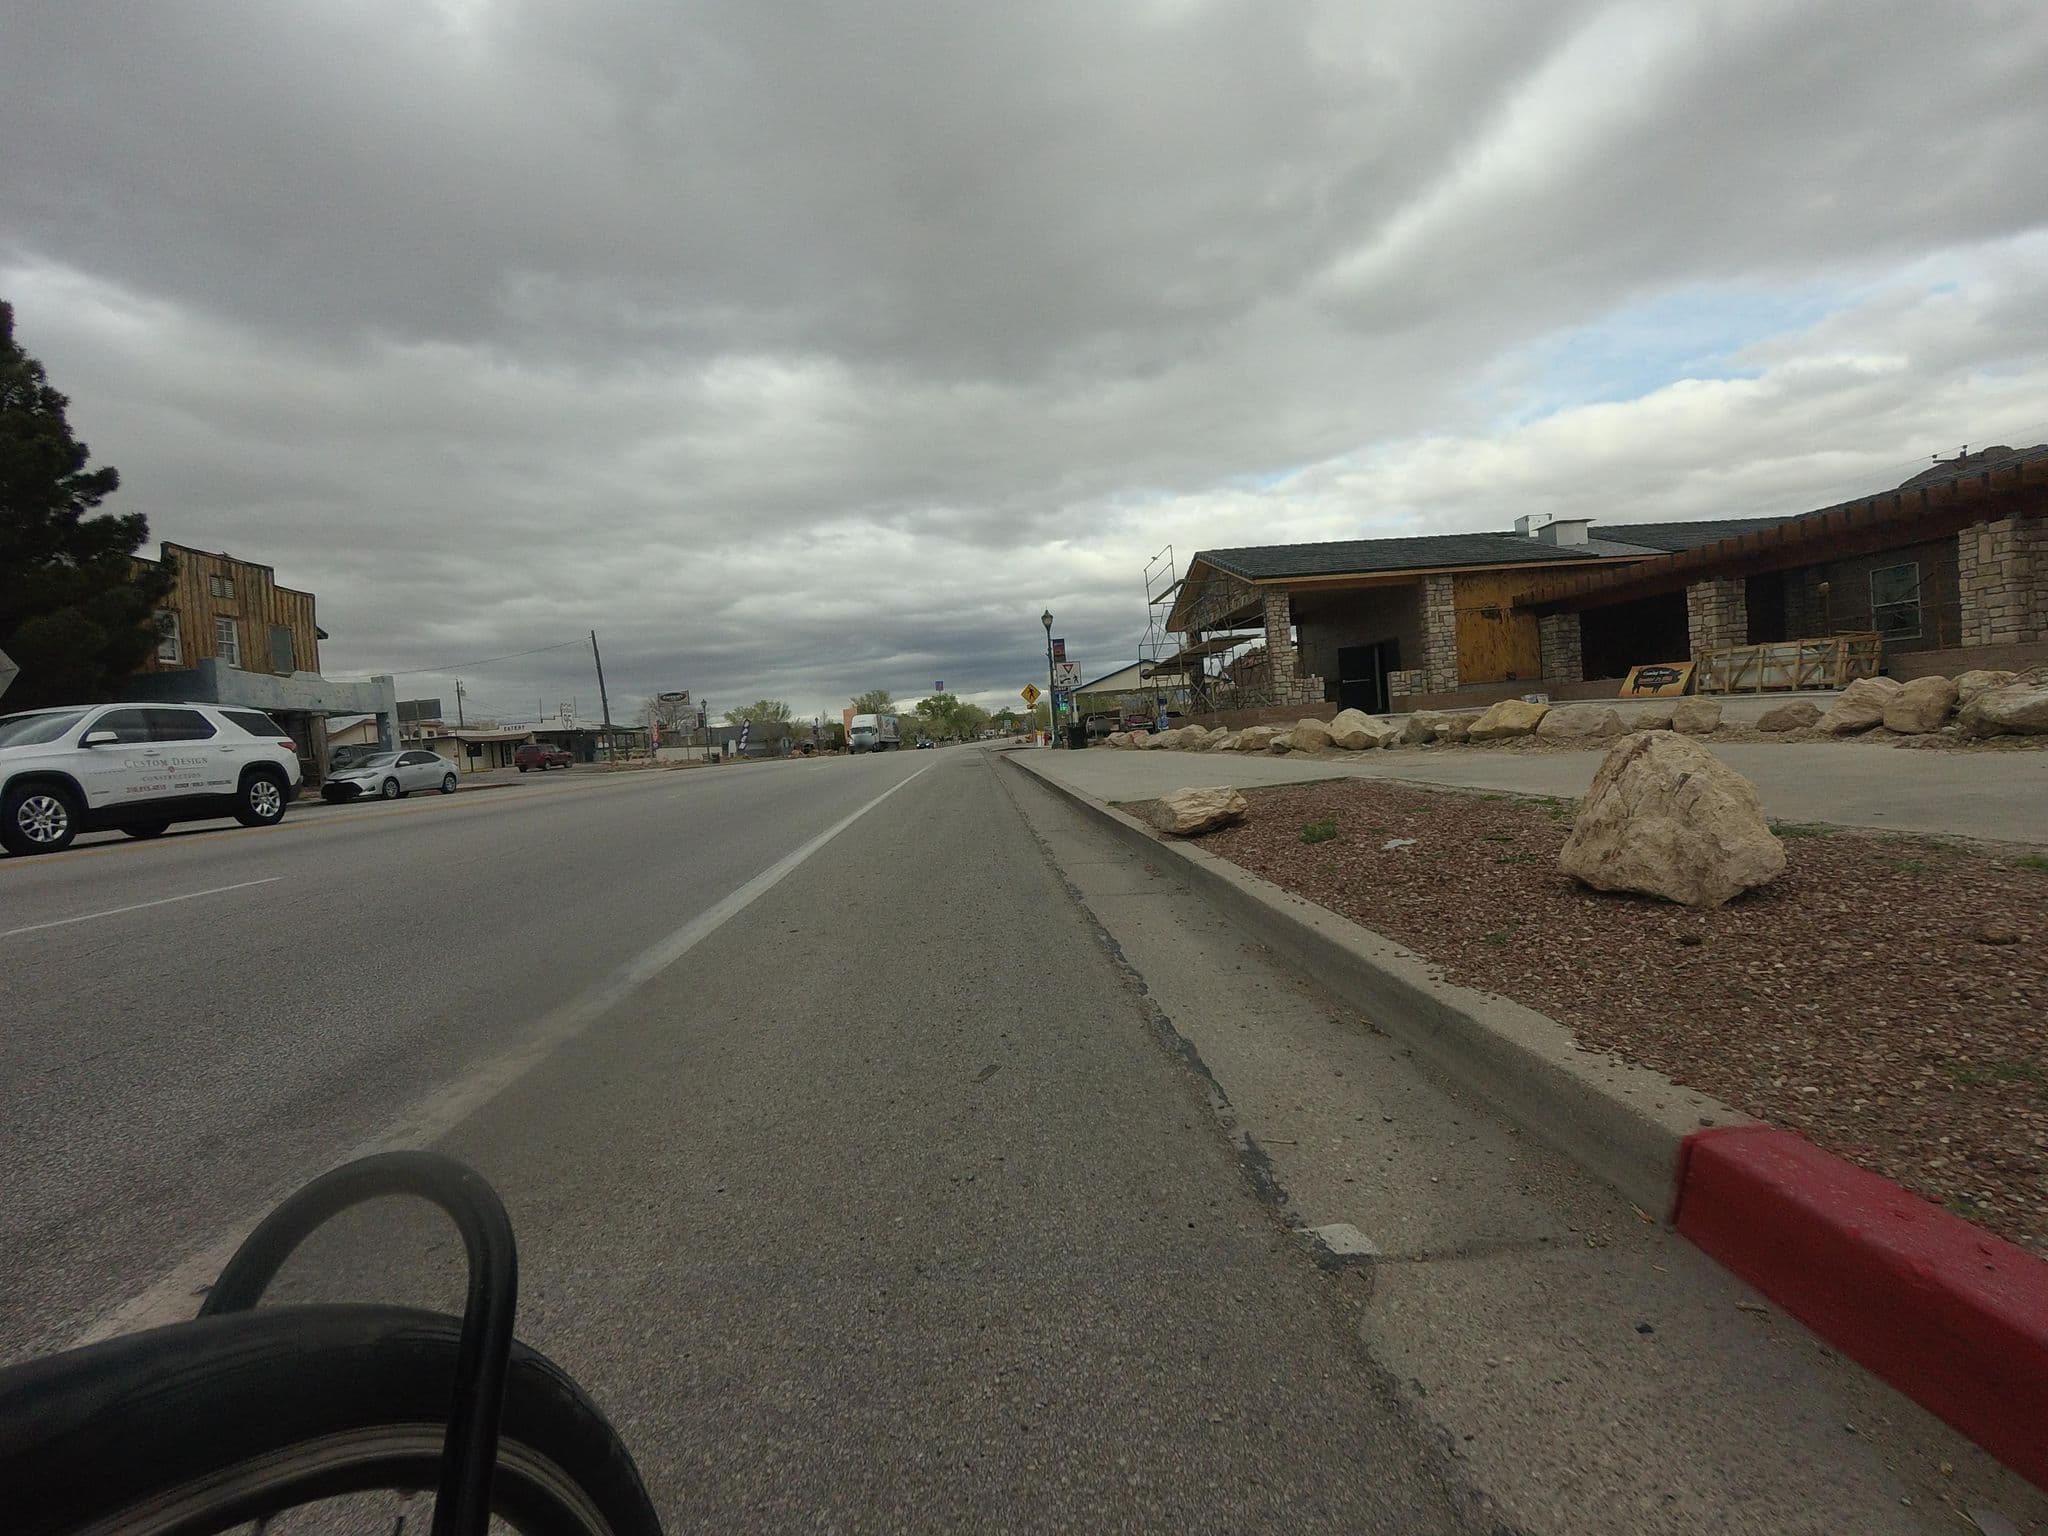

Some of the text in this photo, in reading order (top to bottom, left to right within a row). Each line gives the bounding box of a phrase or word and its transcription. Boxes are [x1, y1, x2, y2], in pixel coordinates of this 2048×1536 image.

[124, 757, 208, 768] CUSTOM DESIGN
[142, 772, 202, 782] CONSTRUCTION
